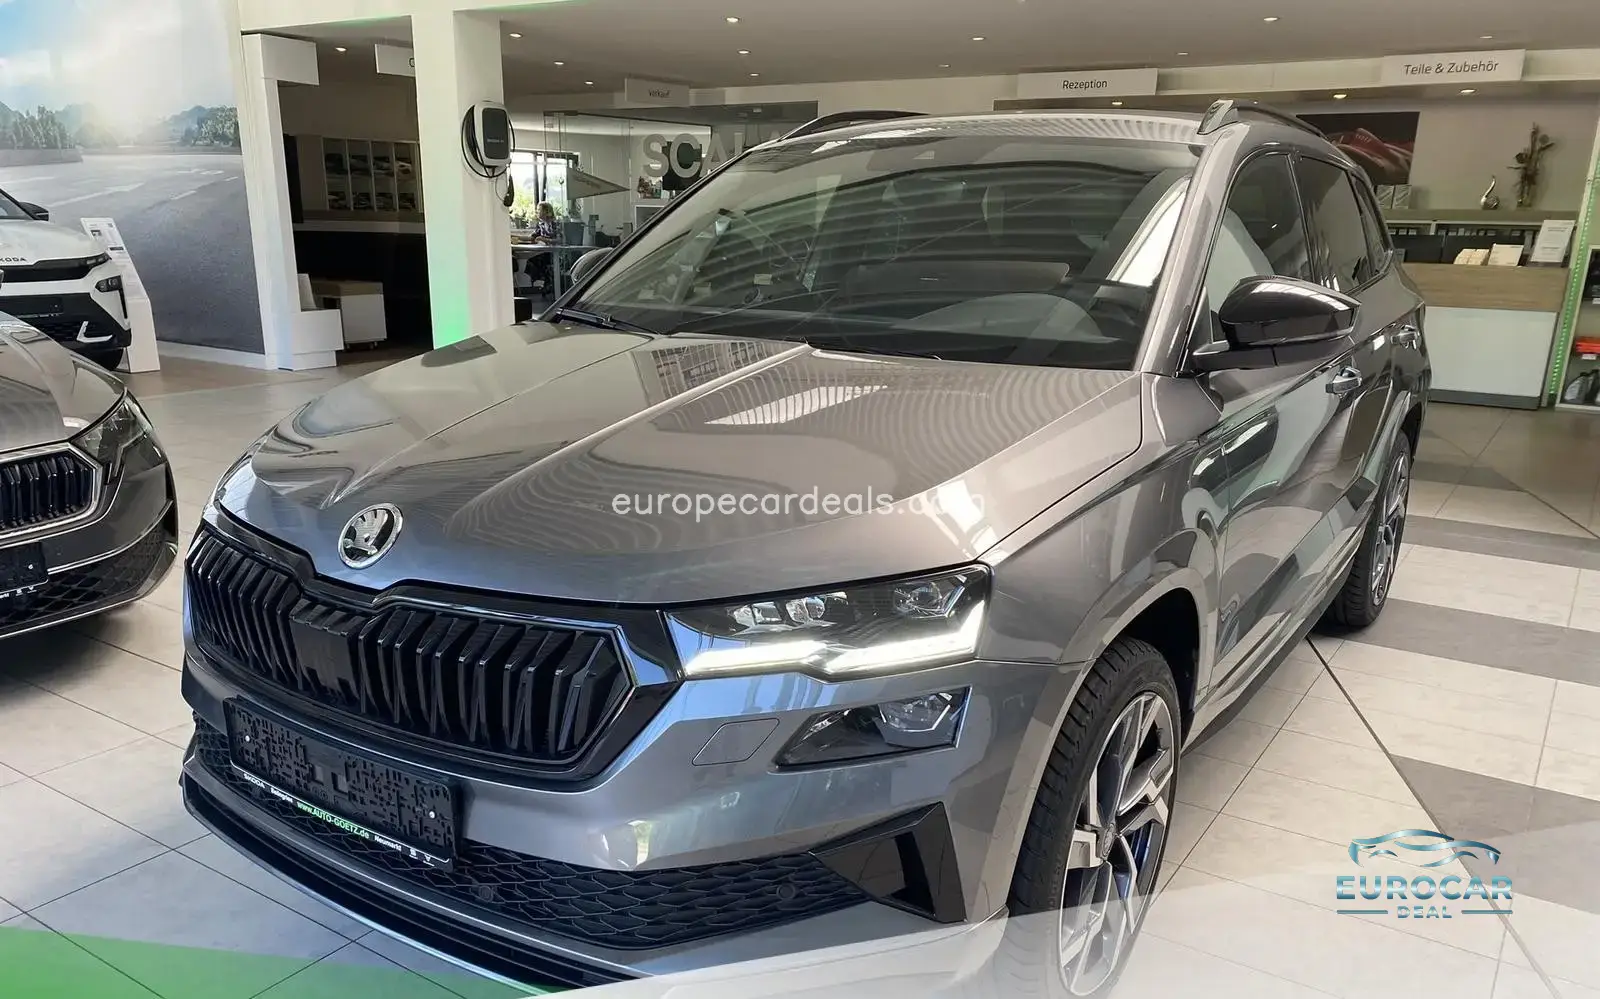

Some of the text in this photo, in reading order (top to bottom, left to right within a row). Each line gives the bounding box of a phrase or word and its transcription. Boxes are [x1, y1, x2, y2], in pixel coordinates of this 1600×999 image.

[1403, 60, 1499, 76] Teile & Zubehör
[1061, 79, 1108, 91] Rezeption
[296, 801, 371, 840] www.AUTO-GOETZ.de
